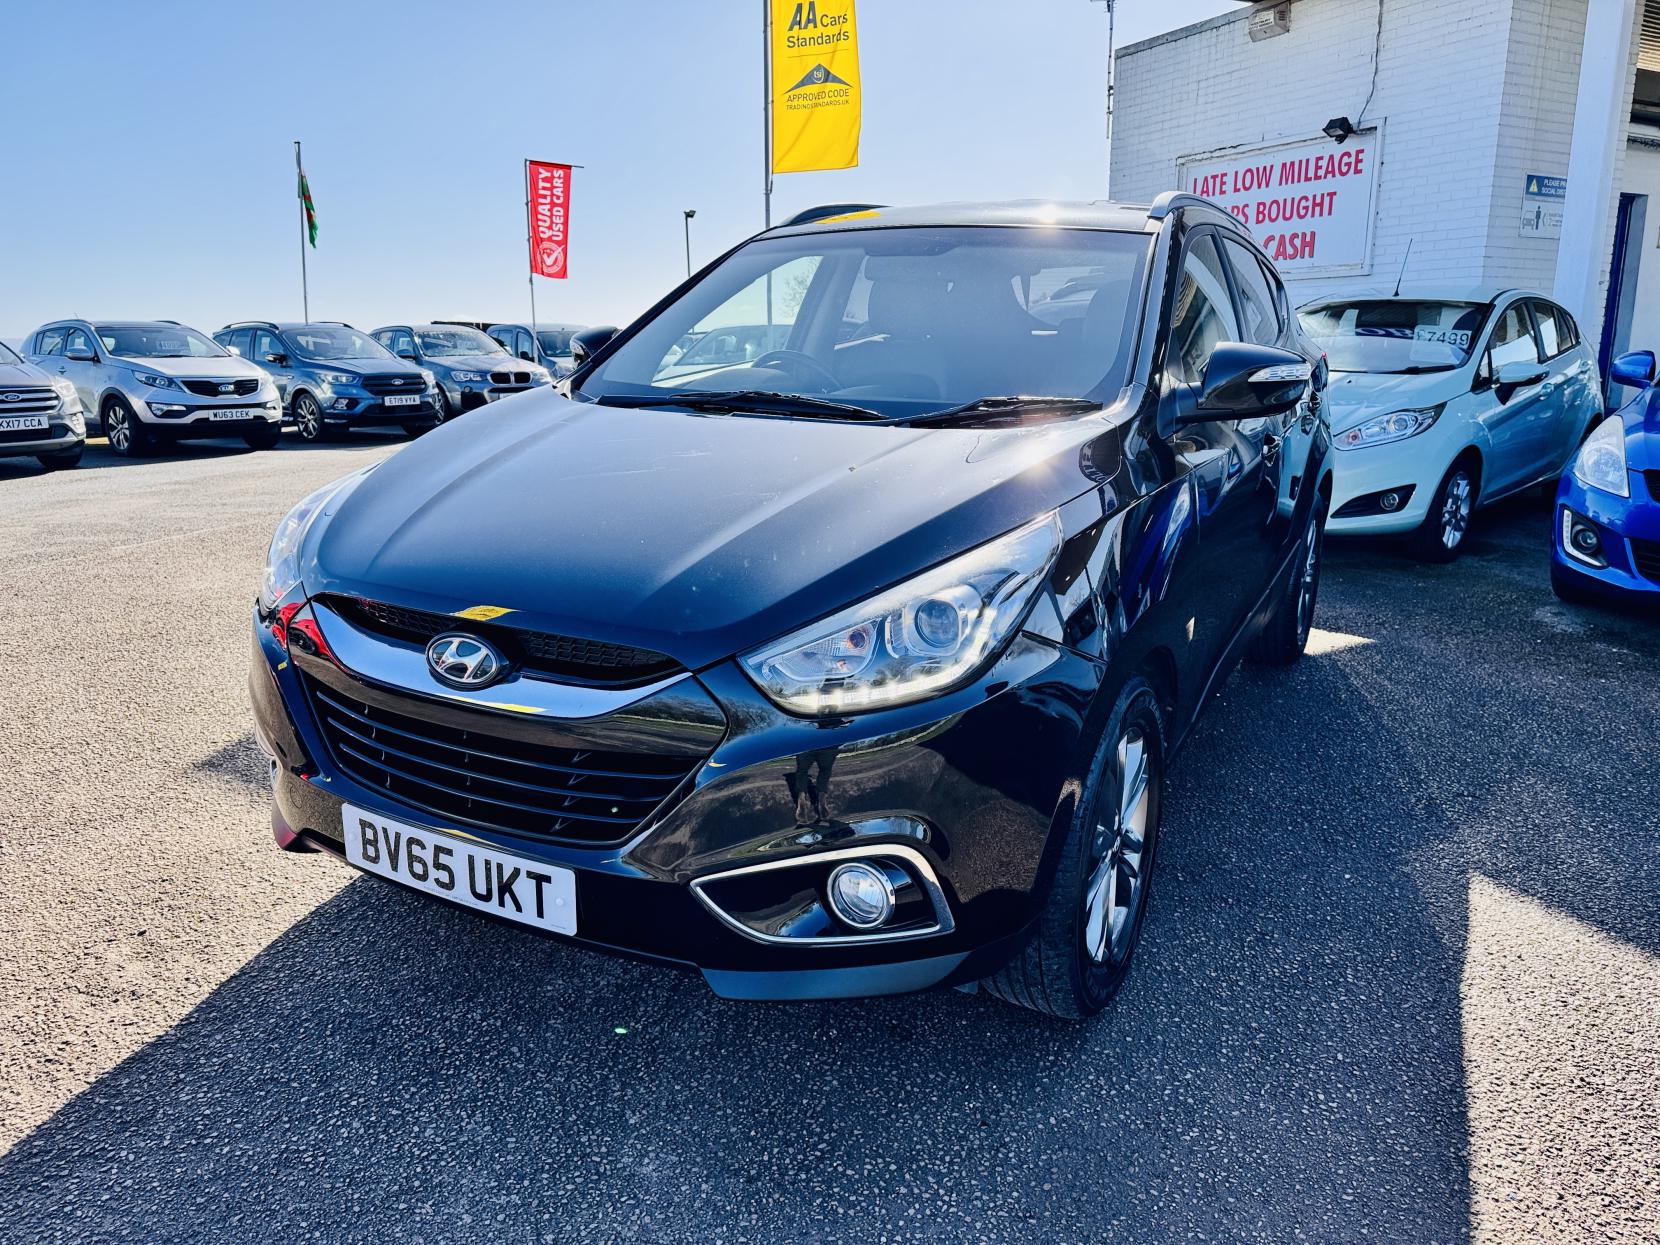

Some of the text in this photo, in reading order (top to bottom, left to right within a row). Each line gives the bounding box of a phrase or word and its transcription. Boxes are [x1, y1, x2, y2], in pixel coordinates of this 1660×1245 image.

[788, 1, 848, 31] AA Cars
[787, 31, 849, 48] Standards
[787, 89, 849, 102] APPROVED CODE
[1193, 148, 1364, 197] LATE LOW MILEAGE
[538, 168, 552, 238] QUALITY
[552, 169, 564, 240] USED CARS
[1255, 191, 1337, 225] BOUGHT
[24, 418, 43, 427] CCA
[236, 410, 250, 418] CEK
[358, 818, 552, 919] BV65 UKT
